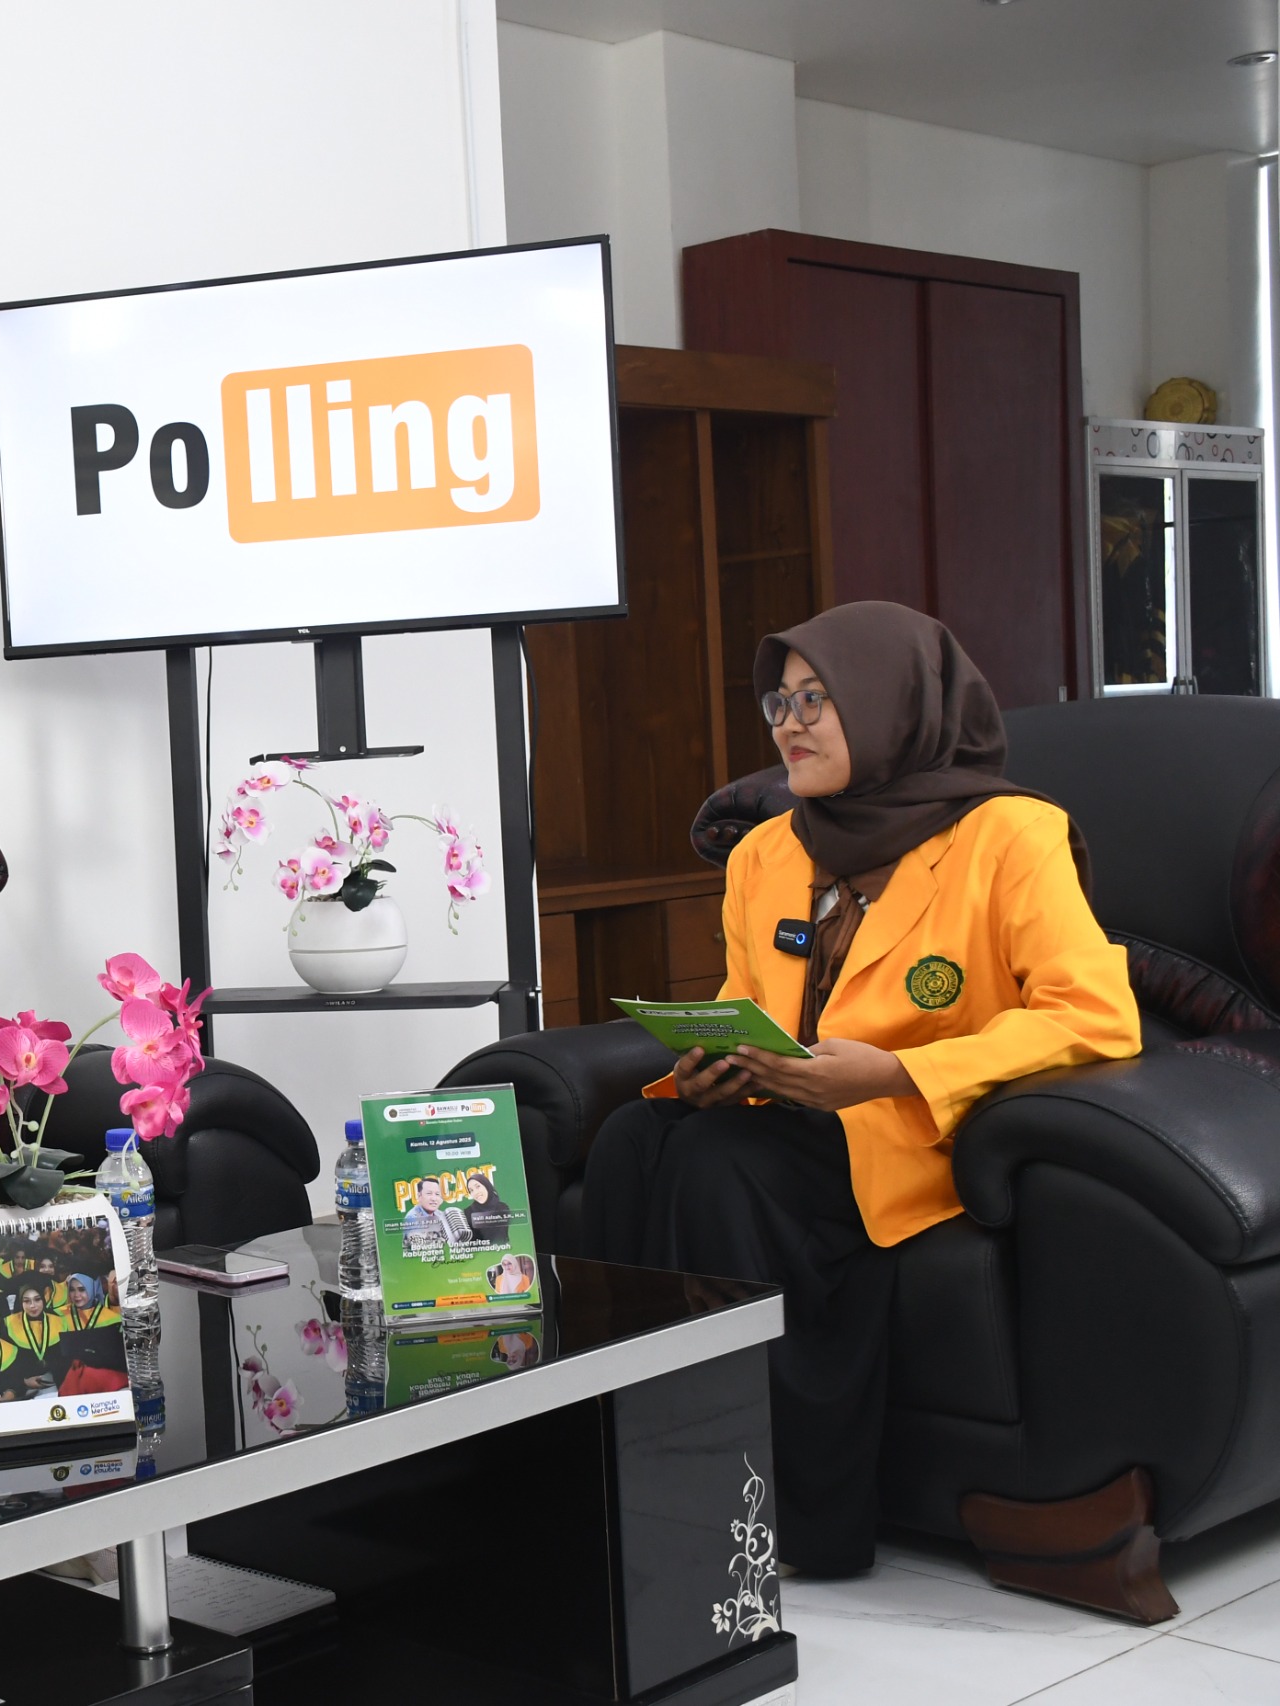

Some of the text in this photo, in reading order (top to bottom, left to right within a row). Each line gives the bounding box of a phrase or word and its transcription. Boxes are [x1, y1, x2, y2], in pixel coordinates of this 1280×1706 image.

[394, 1163, 496, 1212] POCAT
[449, 1238, 490, 1248] Universitas
[402, 1249, 444, 1258] Kabupaten
[450, 1243, 511, 1254] Muhammadiyah
[421, 1254, 445, 1263] Kudus
[450, 1253, 474, 1261] Kudus
[91, 1399, 118, 1409] Kampus
[92, 1405, 120, 1415] Merdeka
